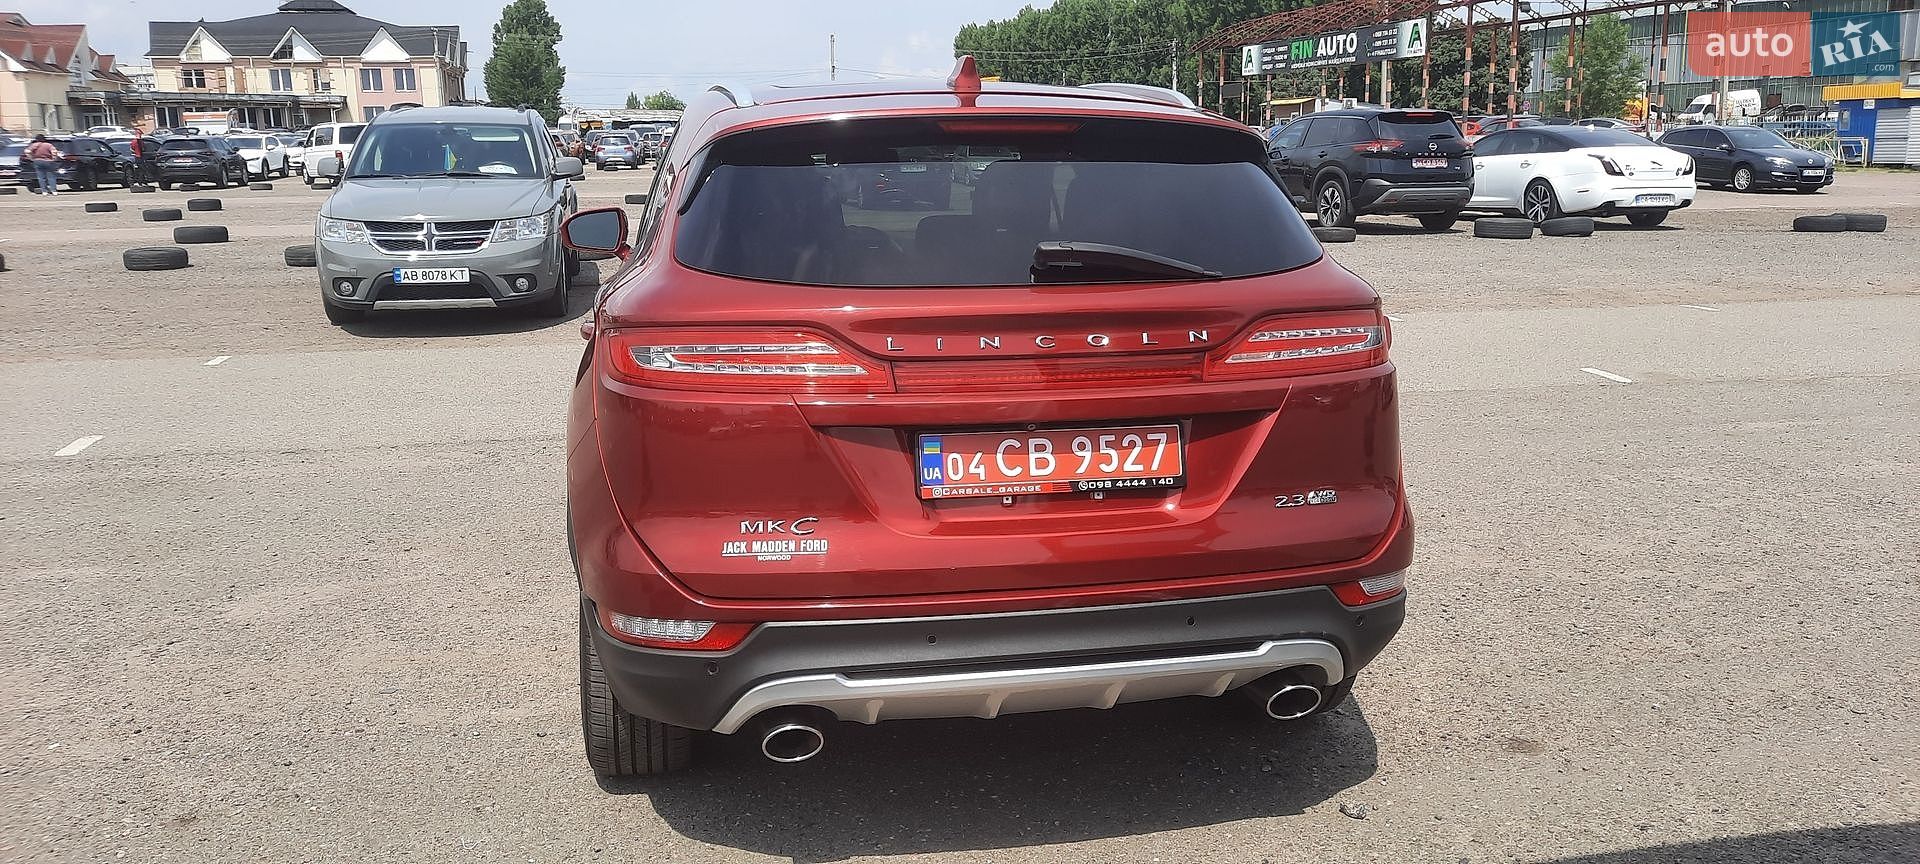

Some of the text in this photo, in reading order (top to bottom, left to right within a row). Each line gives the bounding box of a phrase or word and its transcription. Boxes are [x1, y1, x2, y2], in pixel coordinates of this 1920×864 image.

[1290, 33, 1358, 61] FIN AUTO
[403, 270, 466, 281] AB 8078 KT
[886, 330, 1208, 351] LINCOLN
[946, 433, 1168, 481] 04 CB 9527
[924, 468, 942, 480] UA
[1089, 477, 1174, 489] 098 4444 140
[722, 539, 828, 554] JACK MADDEN FORD
[757, 554, 792, 562] NORWOOD
